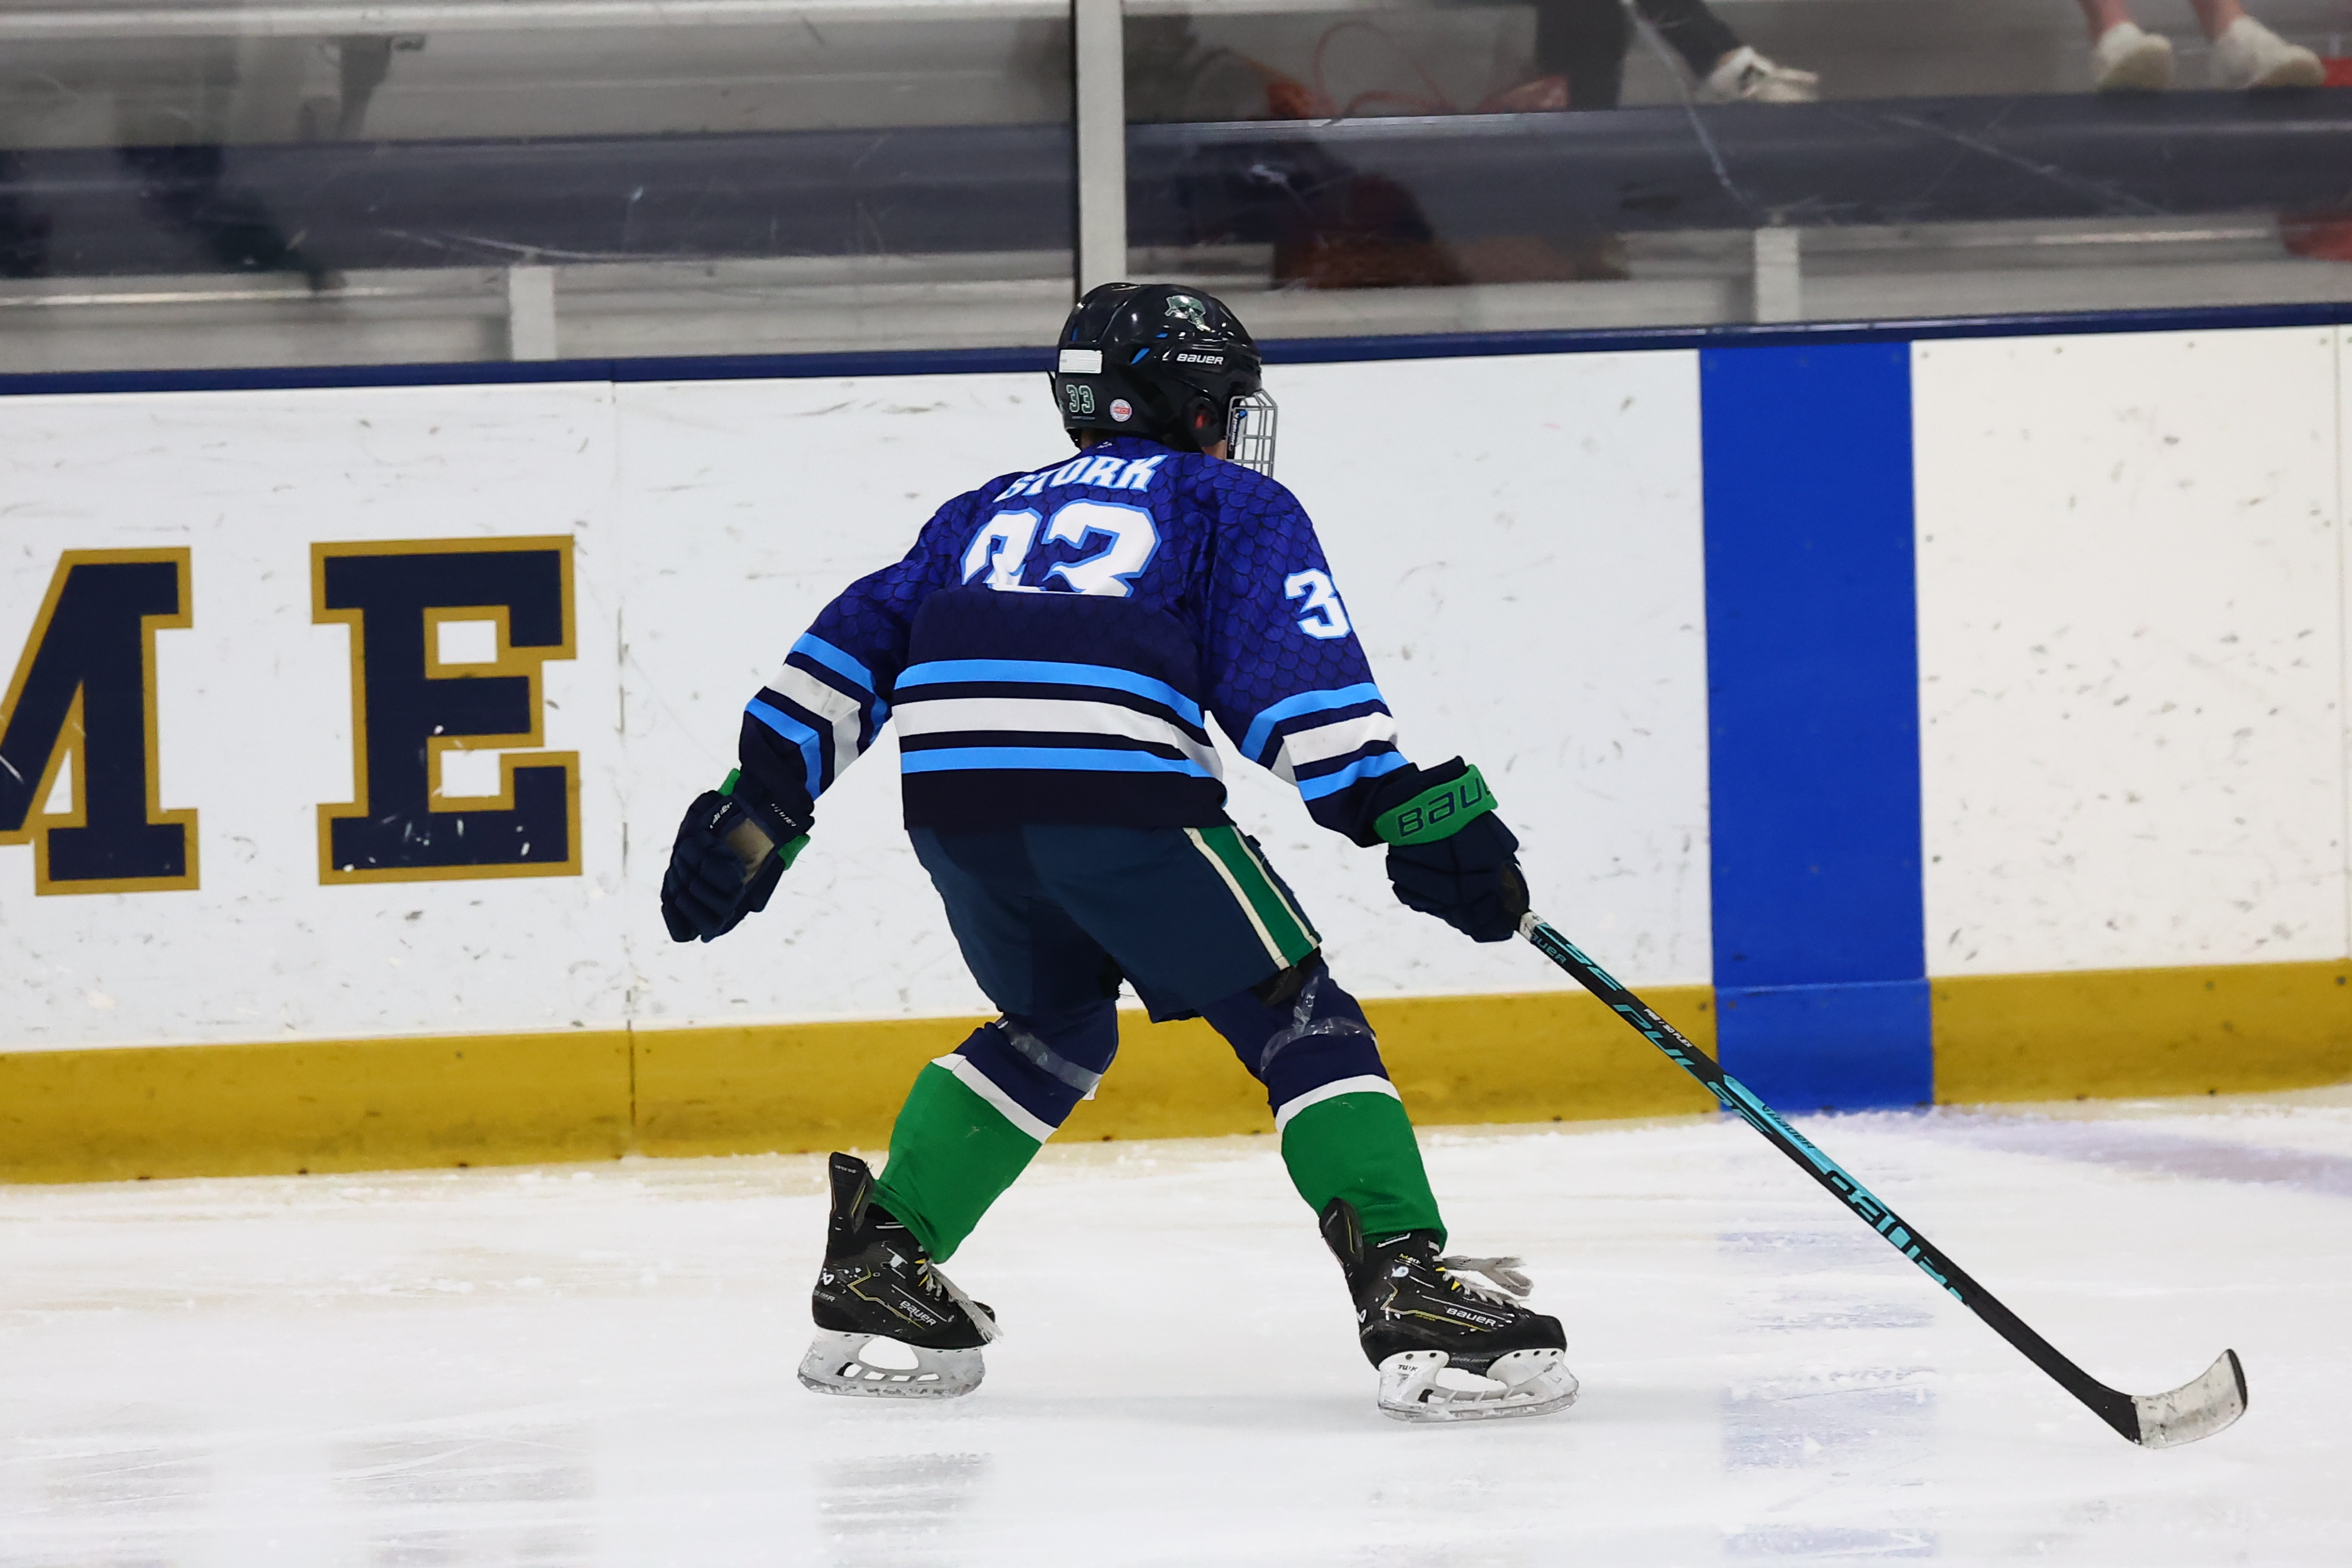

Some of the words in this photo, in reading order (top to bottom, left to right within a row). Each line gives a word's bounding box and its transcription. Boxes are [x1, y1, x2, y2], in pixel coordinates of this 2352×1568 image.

[1177, 353, 1224, 365] BAUER
[1065, 384, 1095, 414] 33
[992, 454, 1168, 503] STORK
[1397, 777, 1491, 837] BAU
[900, 1300, 937, 1326] BAUER
[1446, 1308, 1496, 1327] BAUER
